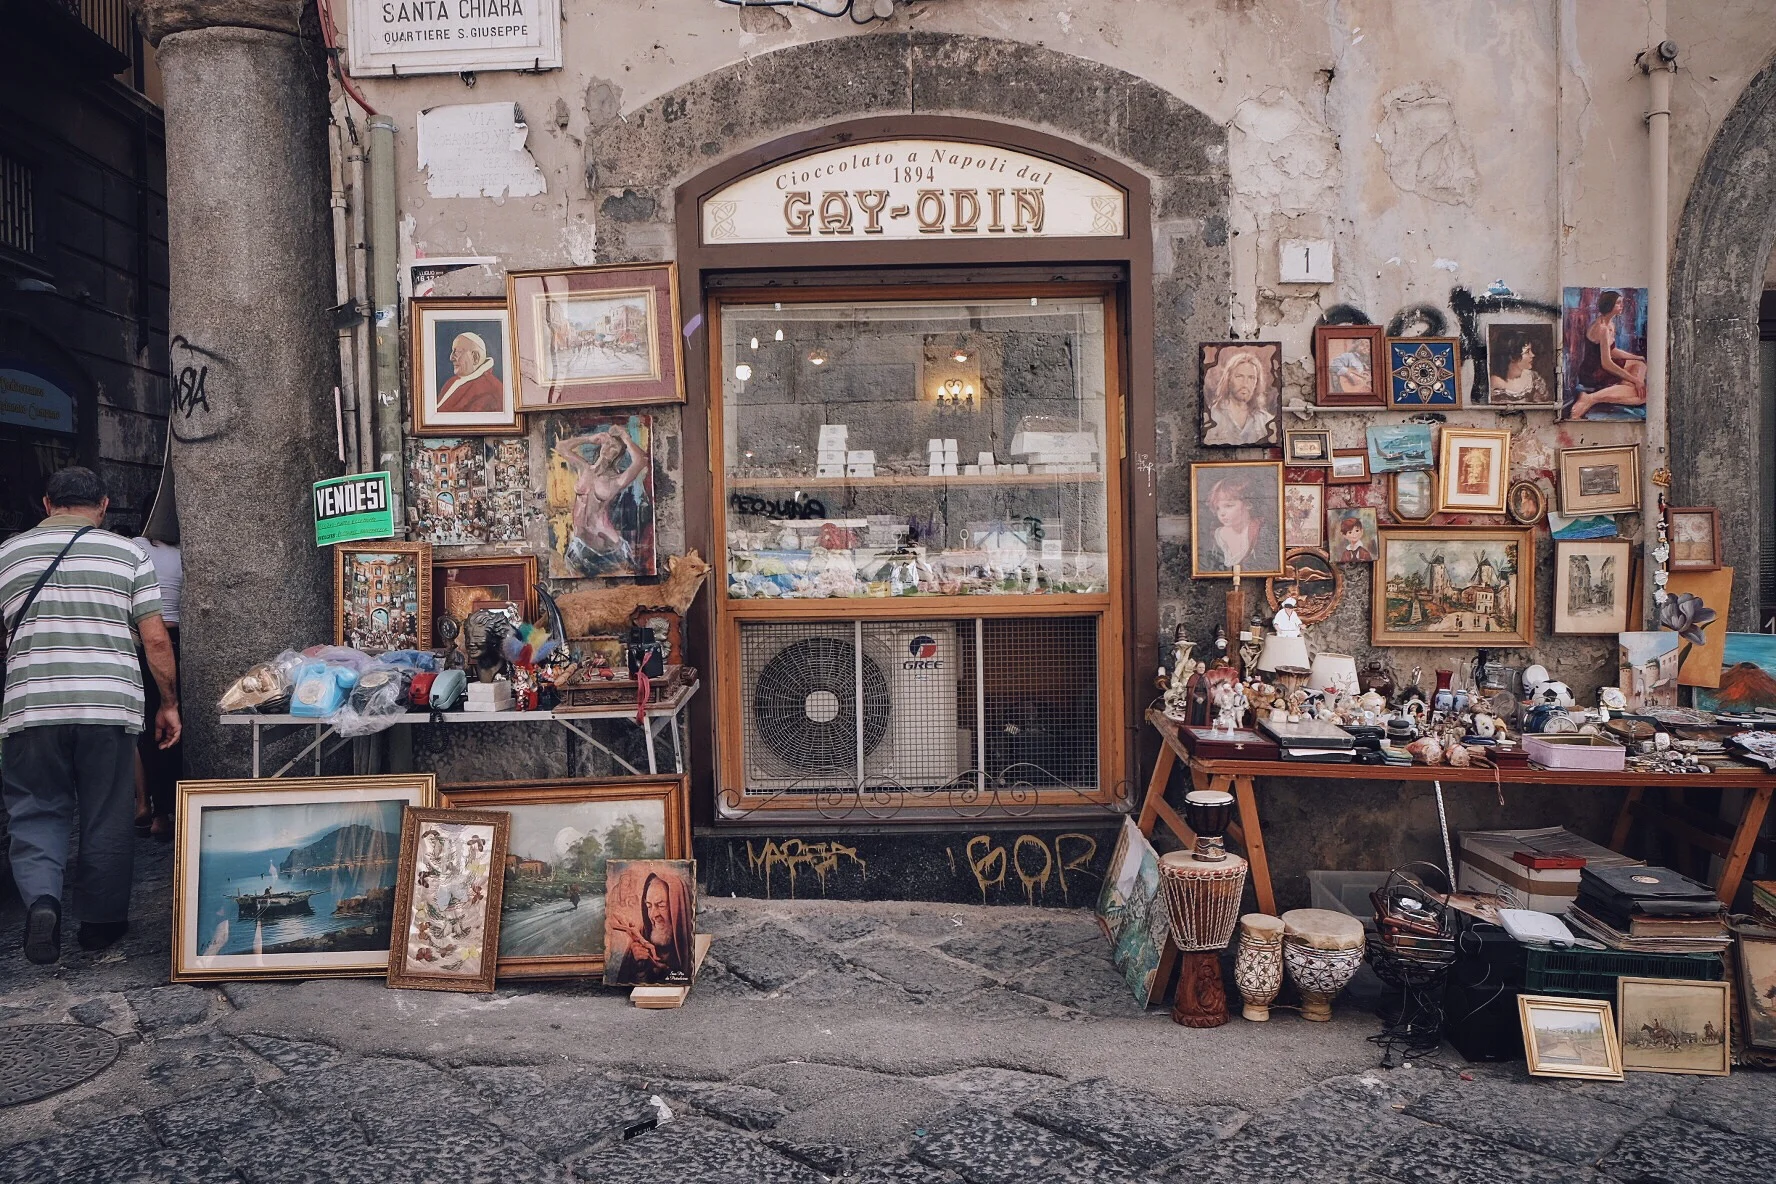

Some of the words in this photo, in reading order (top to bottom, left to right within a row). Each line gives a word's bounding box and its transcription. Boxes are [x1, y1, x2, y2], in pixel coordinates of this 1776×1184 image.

[383, 1, 449, 23] SANTA
[459, 0, 523, 19] CHIARA
[384, 29, 450, 44] QUARTIERE
[457, 25, 528, 39] S.GIUSEPPE
[776, 153, 893, 190] Cioccolato
[907, 152, 918, 163] a
[931, 149, 1007, 173] Napoli
[1016, 165, 1052, 186] dal
[893, 166, 935, 183] 1894
[783, 188, 1046, 234] GAY-ODIN
[316, 480, 385, 517] VENDESI
[903, 660, 944, 670] GREE
